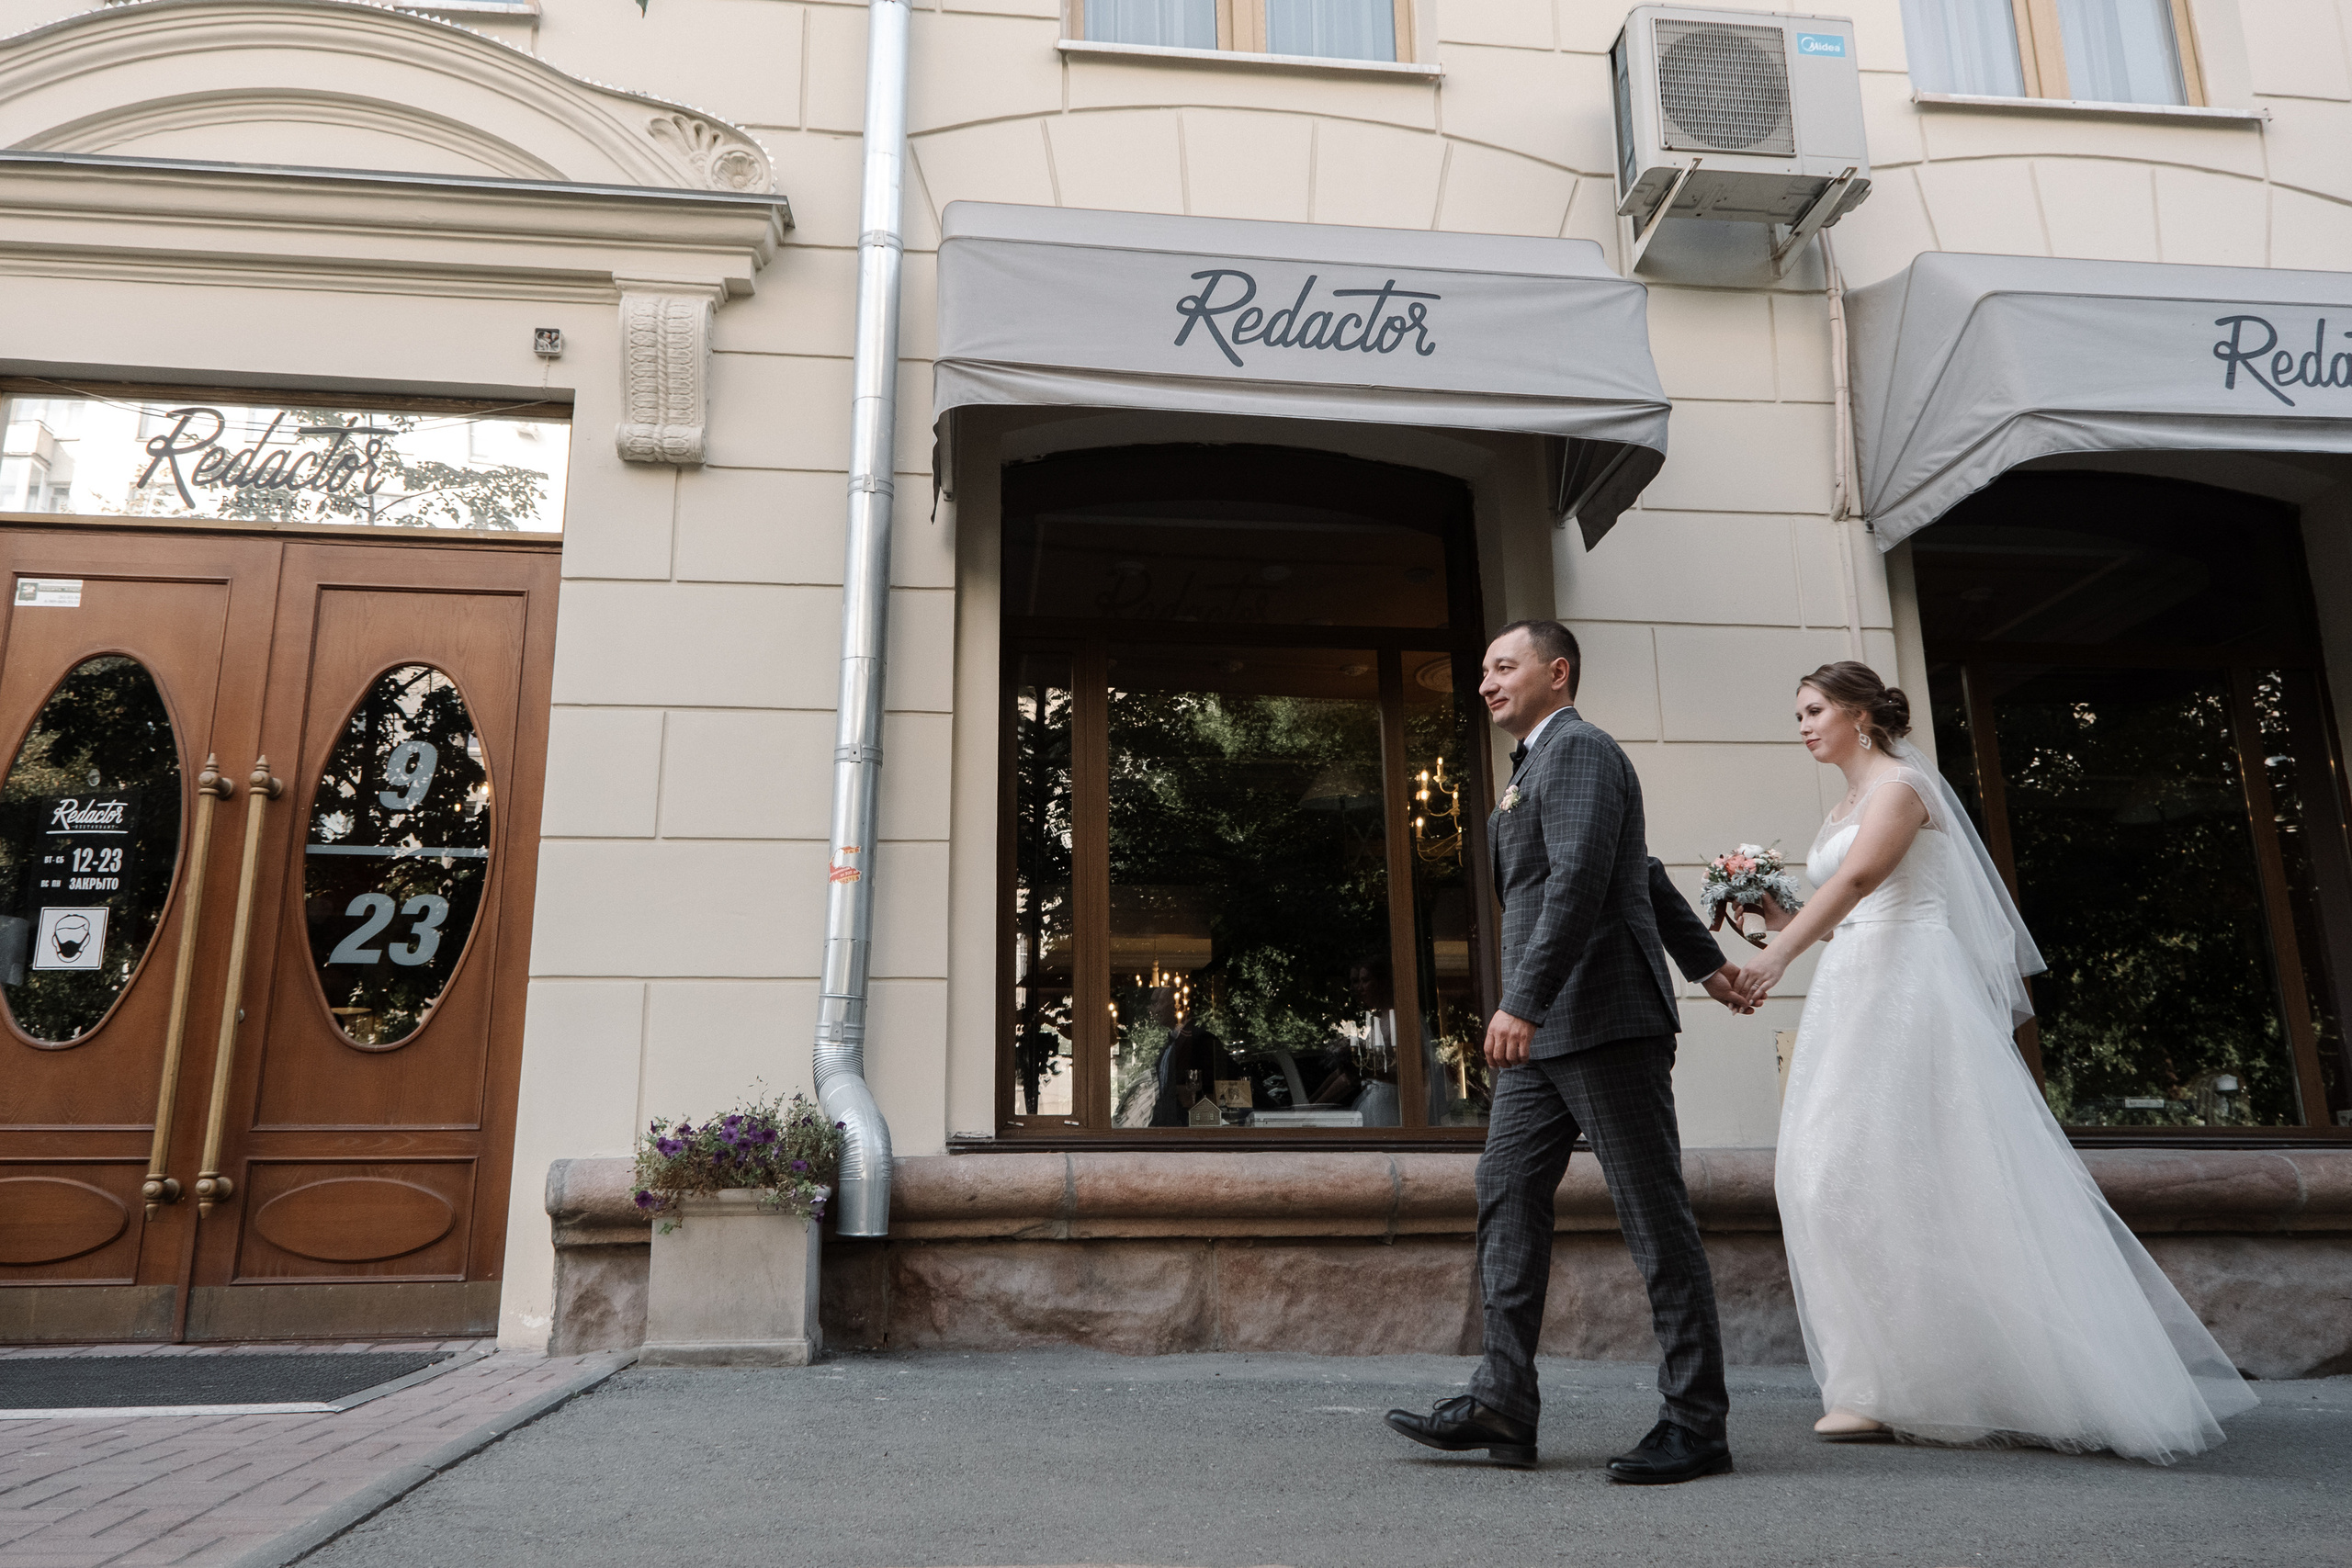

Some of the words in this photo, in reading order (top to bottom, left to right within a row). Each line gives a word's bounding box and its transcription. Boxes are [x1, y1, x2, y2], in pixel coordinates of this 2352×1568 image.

[1804, 39, 1840, 52] Midea
[1173, 269, 1442, 367] Redactor
[136, 407, 399, 509] Redactor
[379, 740, 438, 810] 9
[51, 798, 129, 830] Redactor
[69, 877, 119, 890] ЗАКРЫТО
[73, 847, 123, 873] 12-23
[328, 892, 449, 966] 23
